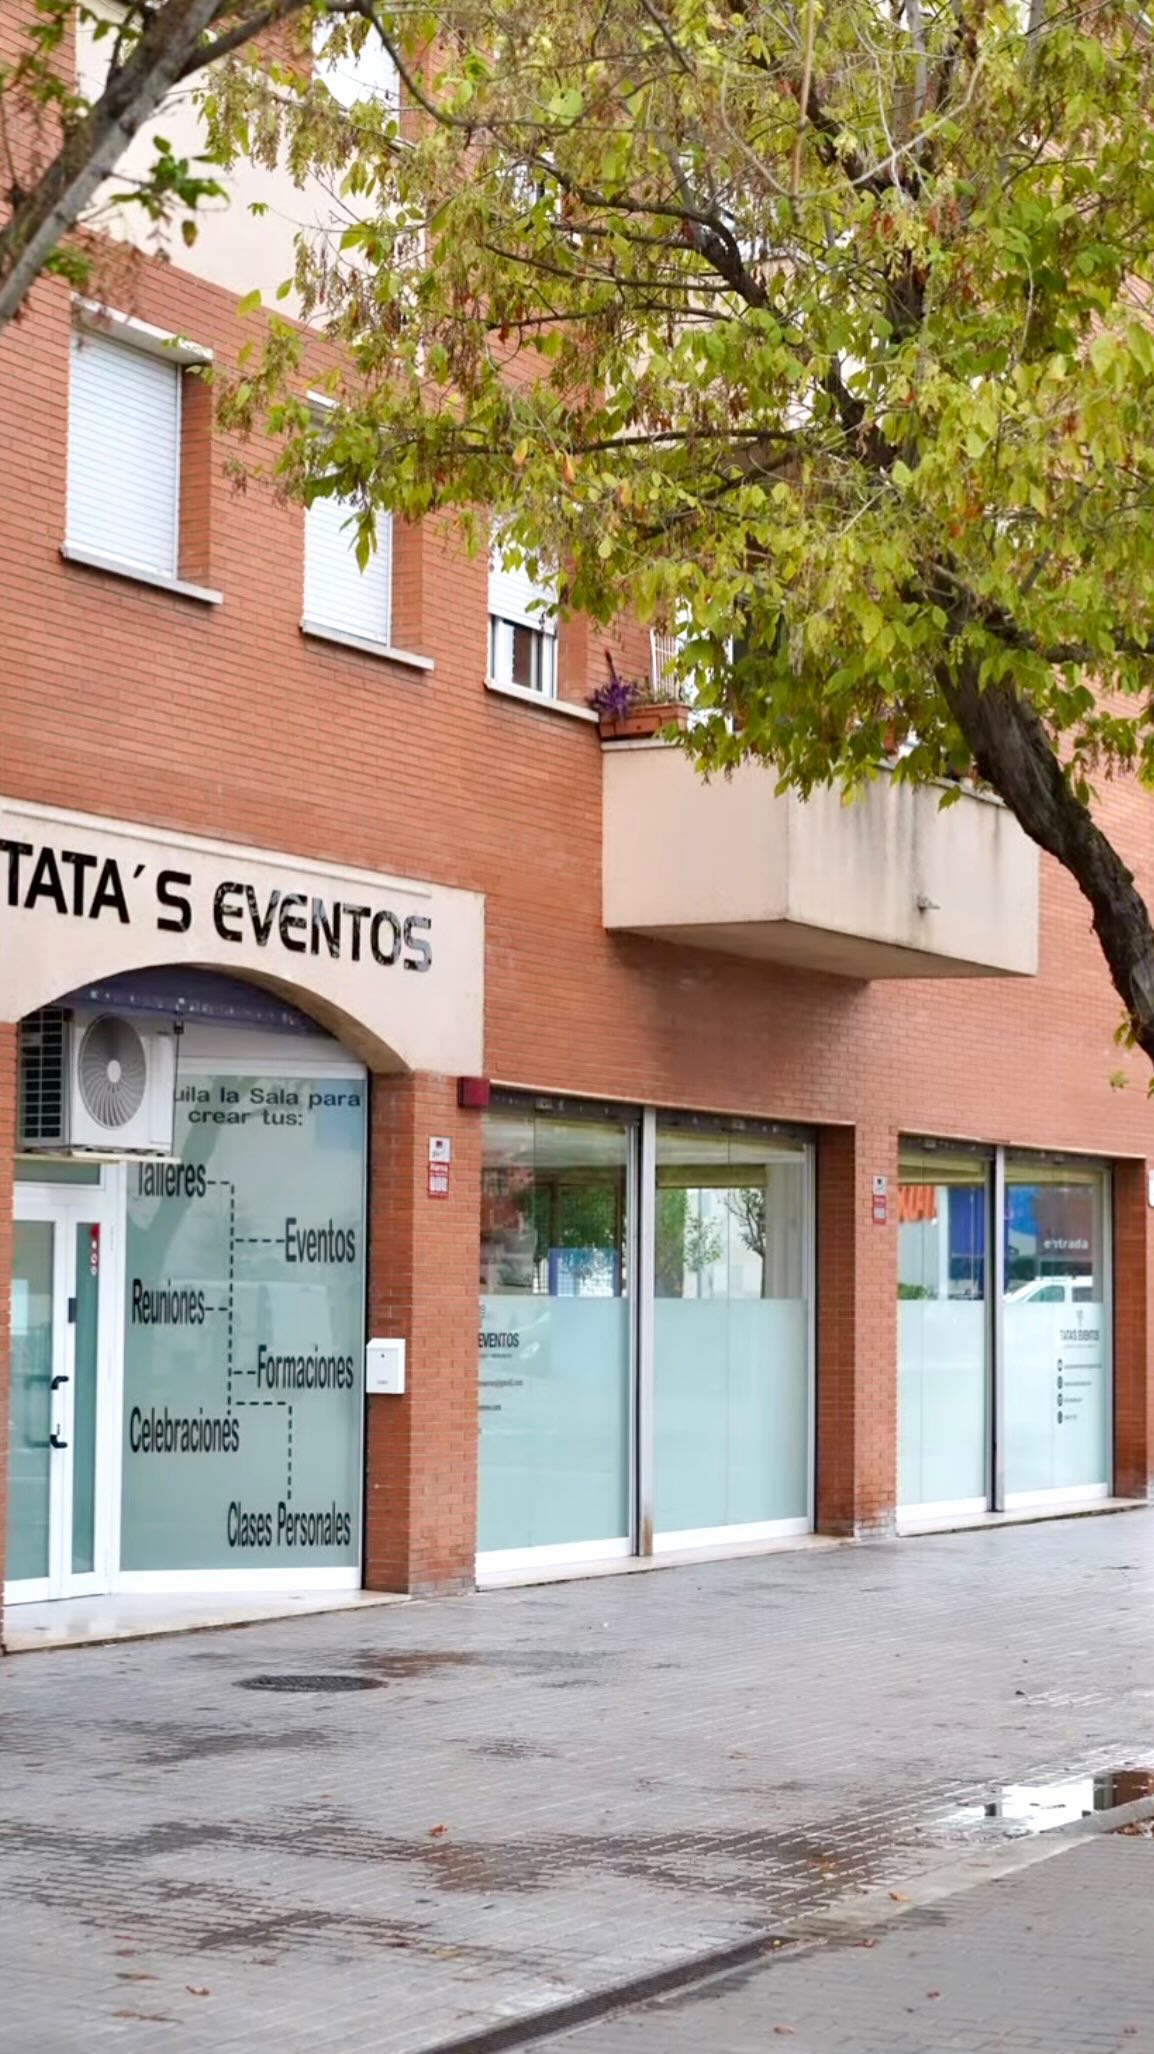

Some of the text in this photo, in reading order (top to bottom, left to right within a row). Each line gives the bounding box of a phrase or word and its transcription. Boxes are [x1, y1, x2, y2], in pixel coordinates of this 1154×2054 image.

[213, 880, 433, 974] EVENTOS
[188, 1109, 303, 1127] crear tus:
[221, 1087, 240, 1104] la
[250, 1088, 299, 1106] Sala
[309, 1091, 362, 1110] para
[285, 1217, 355, 1263] Eventos
[132, 1277, 205, 1325] Reuniones
[478, 1332, 520, 1348] EVENTOS
[257, 1344, 354, 1389] Formaciones
[130, 1406, 240, 1453] Celebraciones
[227, 1501, 351, 1547] Clases Personales
